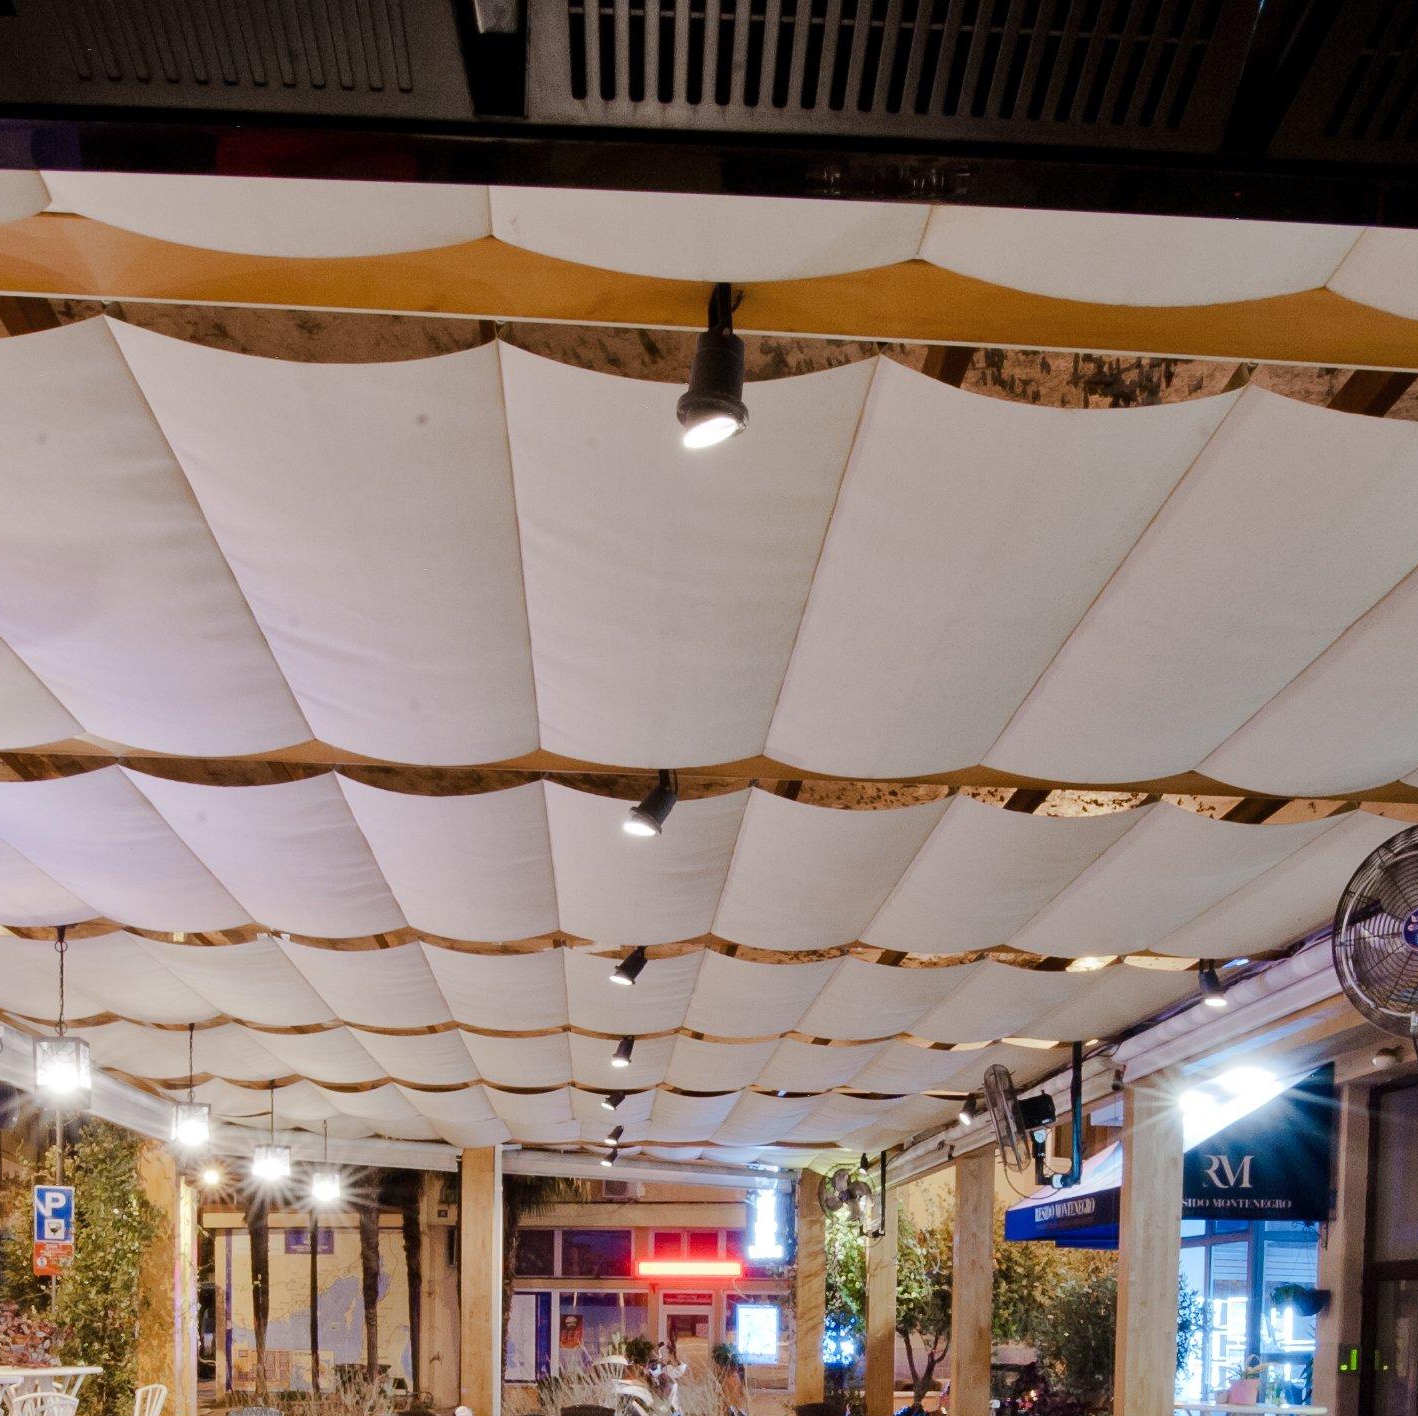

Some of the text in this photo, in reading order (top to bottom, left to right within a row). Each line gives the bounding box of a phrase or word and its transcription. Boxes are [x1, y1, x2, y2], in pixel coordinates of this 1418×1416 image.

[1202, 1154, 1255, 1189] RM
[45, 1191, 66, 1217] P
[1212, 1198, 1292, 1209] MONTENEGRO
